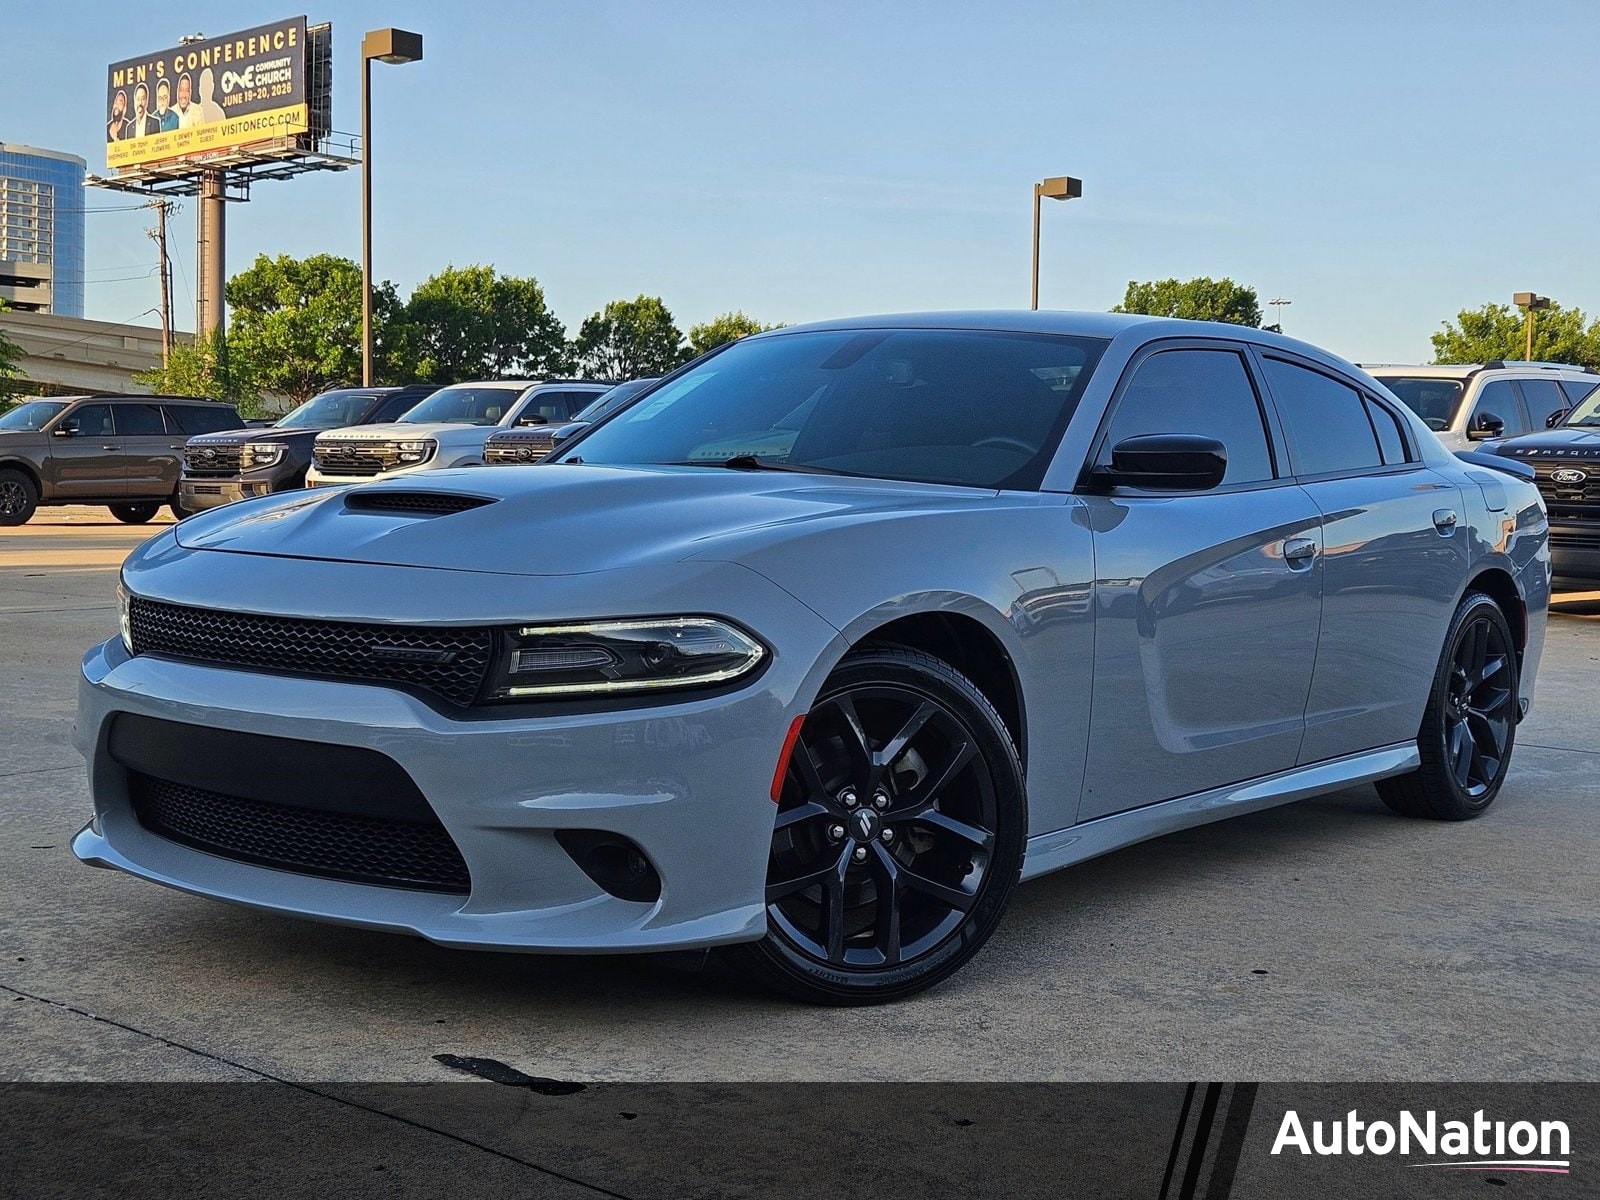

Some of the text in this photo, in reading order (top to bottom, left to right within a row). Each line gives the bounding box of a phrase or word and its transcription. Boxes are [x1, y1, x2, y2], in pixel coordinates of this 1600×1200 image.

[113, 27, 297, 88] MEN'S CONFERENCE
[255, 56, 291, 72] COMMUNITY
[221, 65, 254, 93] ONE
[255, 67, 292, 86] CHURCH
[222, 81, 292, 107] JUNE 19-20, 2026
[196, 126, 218, 136] SURPRISE
[221, 111, 300, 136] VISITONECC.COM
[200, 134, 215, 143] GUEST
